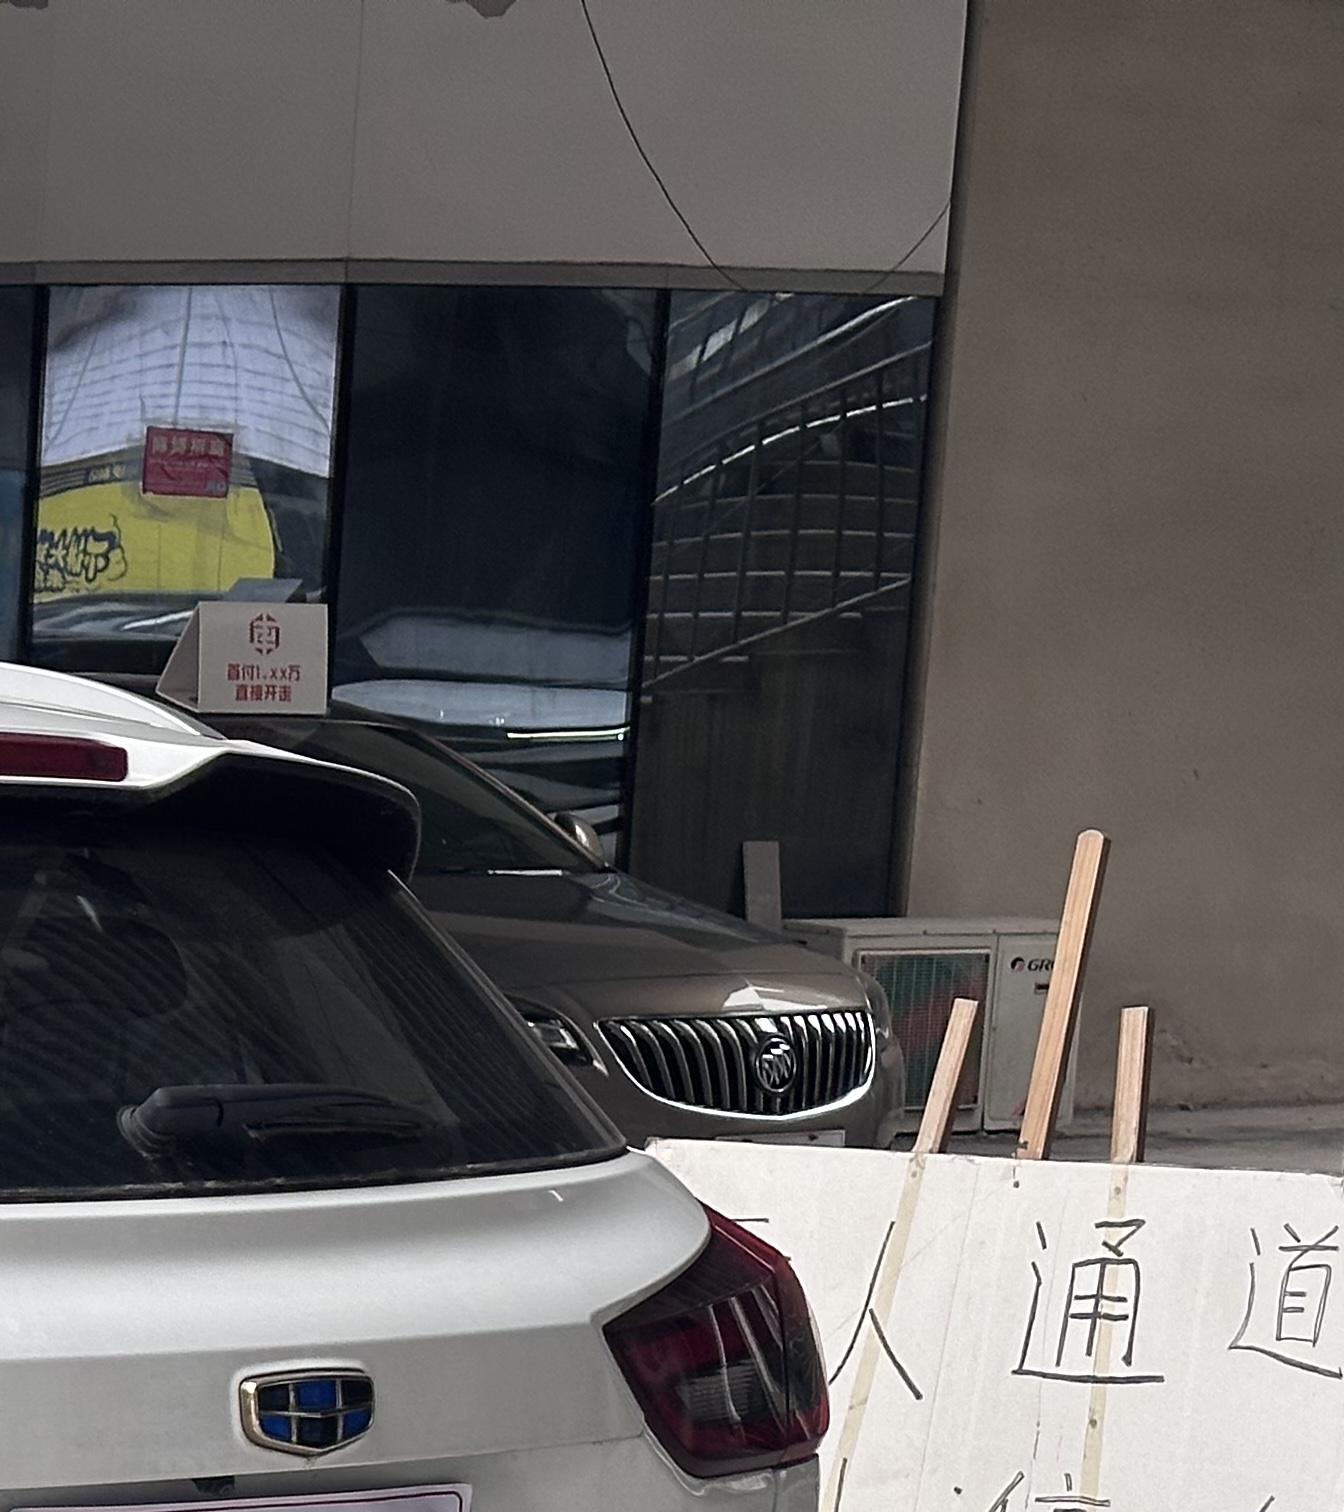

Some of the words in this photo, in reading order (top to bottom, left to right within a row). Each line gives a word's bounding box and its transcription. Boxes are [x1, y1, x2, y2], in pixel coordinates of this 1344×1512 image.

[236, 684, 292, 702] 直接开走
[1027, 959, 1055, 972] GR
[733, 1216, 1343, 1400] 人通道
